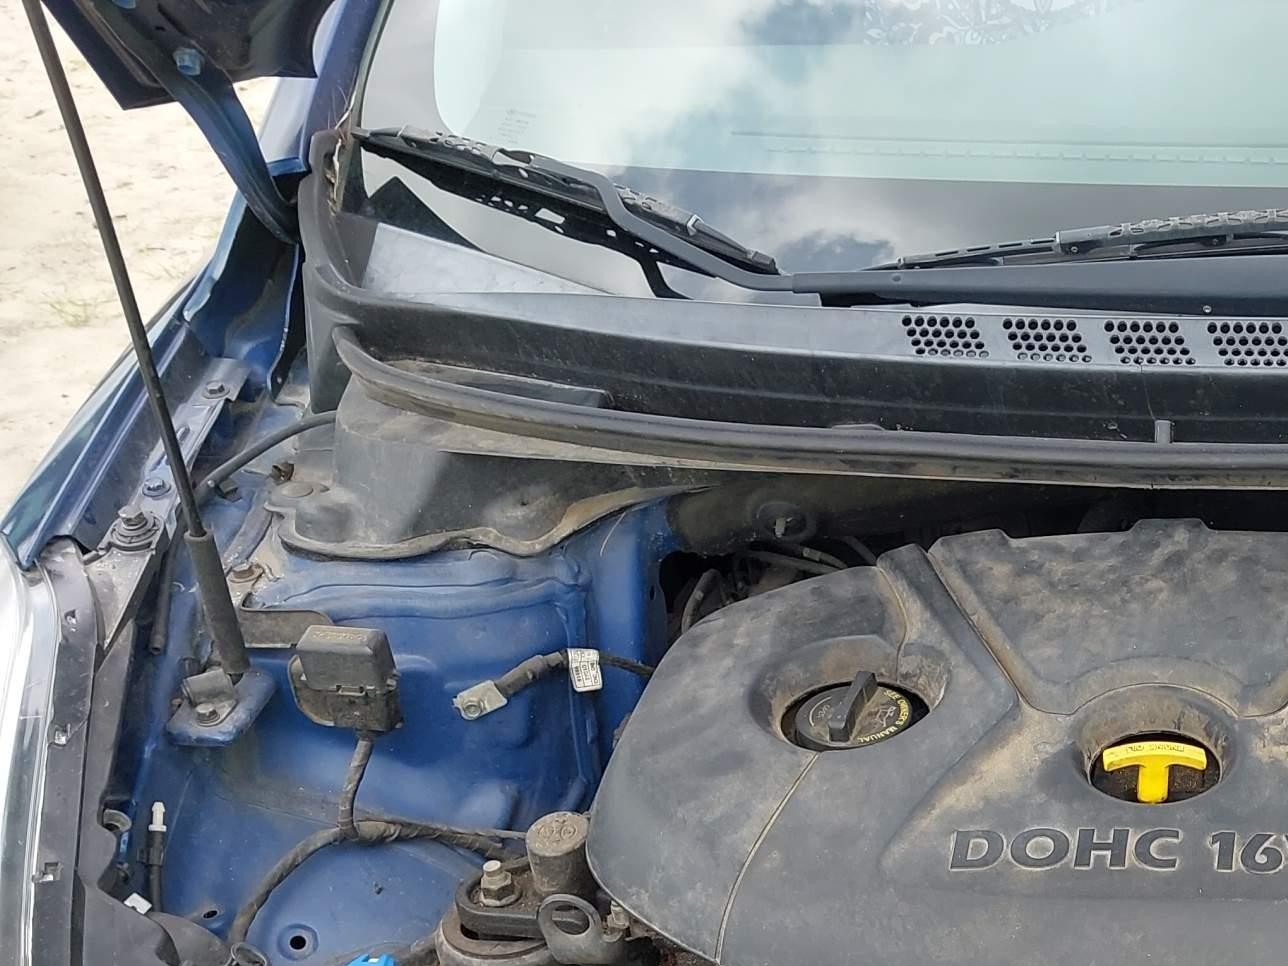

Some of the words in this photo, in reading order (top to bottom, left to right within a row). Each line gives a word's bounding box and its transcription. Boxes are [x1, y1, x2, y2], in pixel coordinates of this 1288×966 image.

[883, 689, 901, 703] SEE
[858, 725, 898, 743] MANUAL
[949, 827, 1183, 871] DOHC
